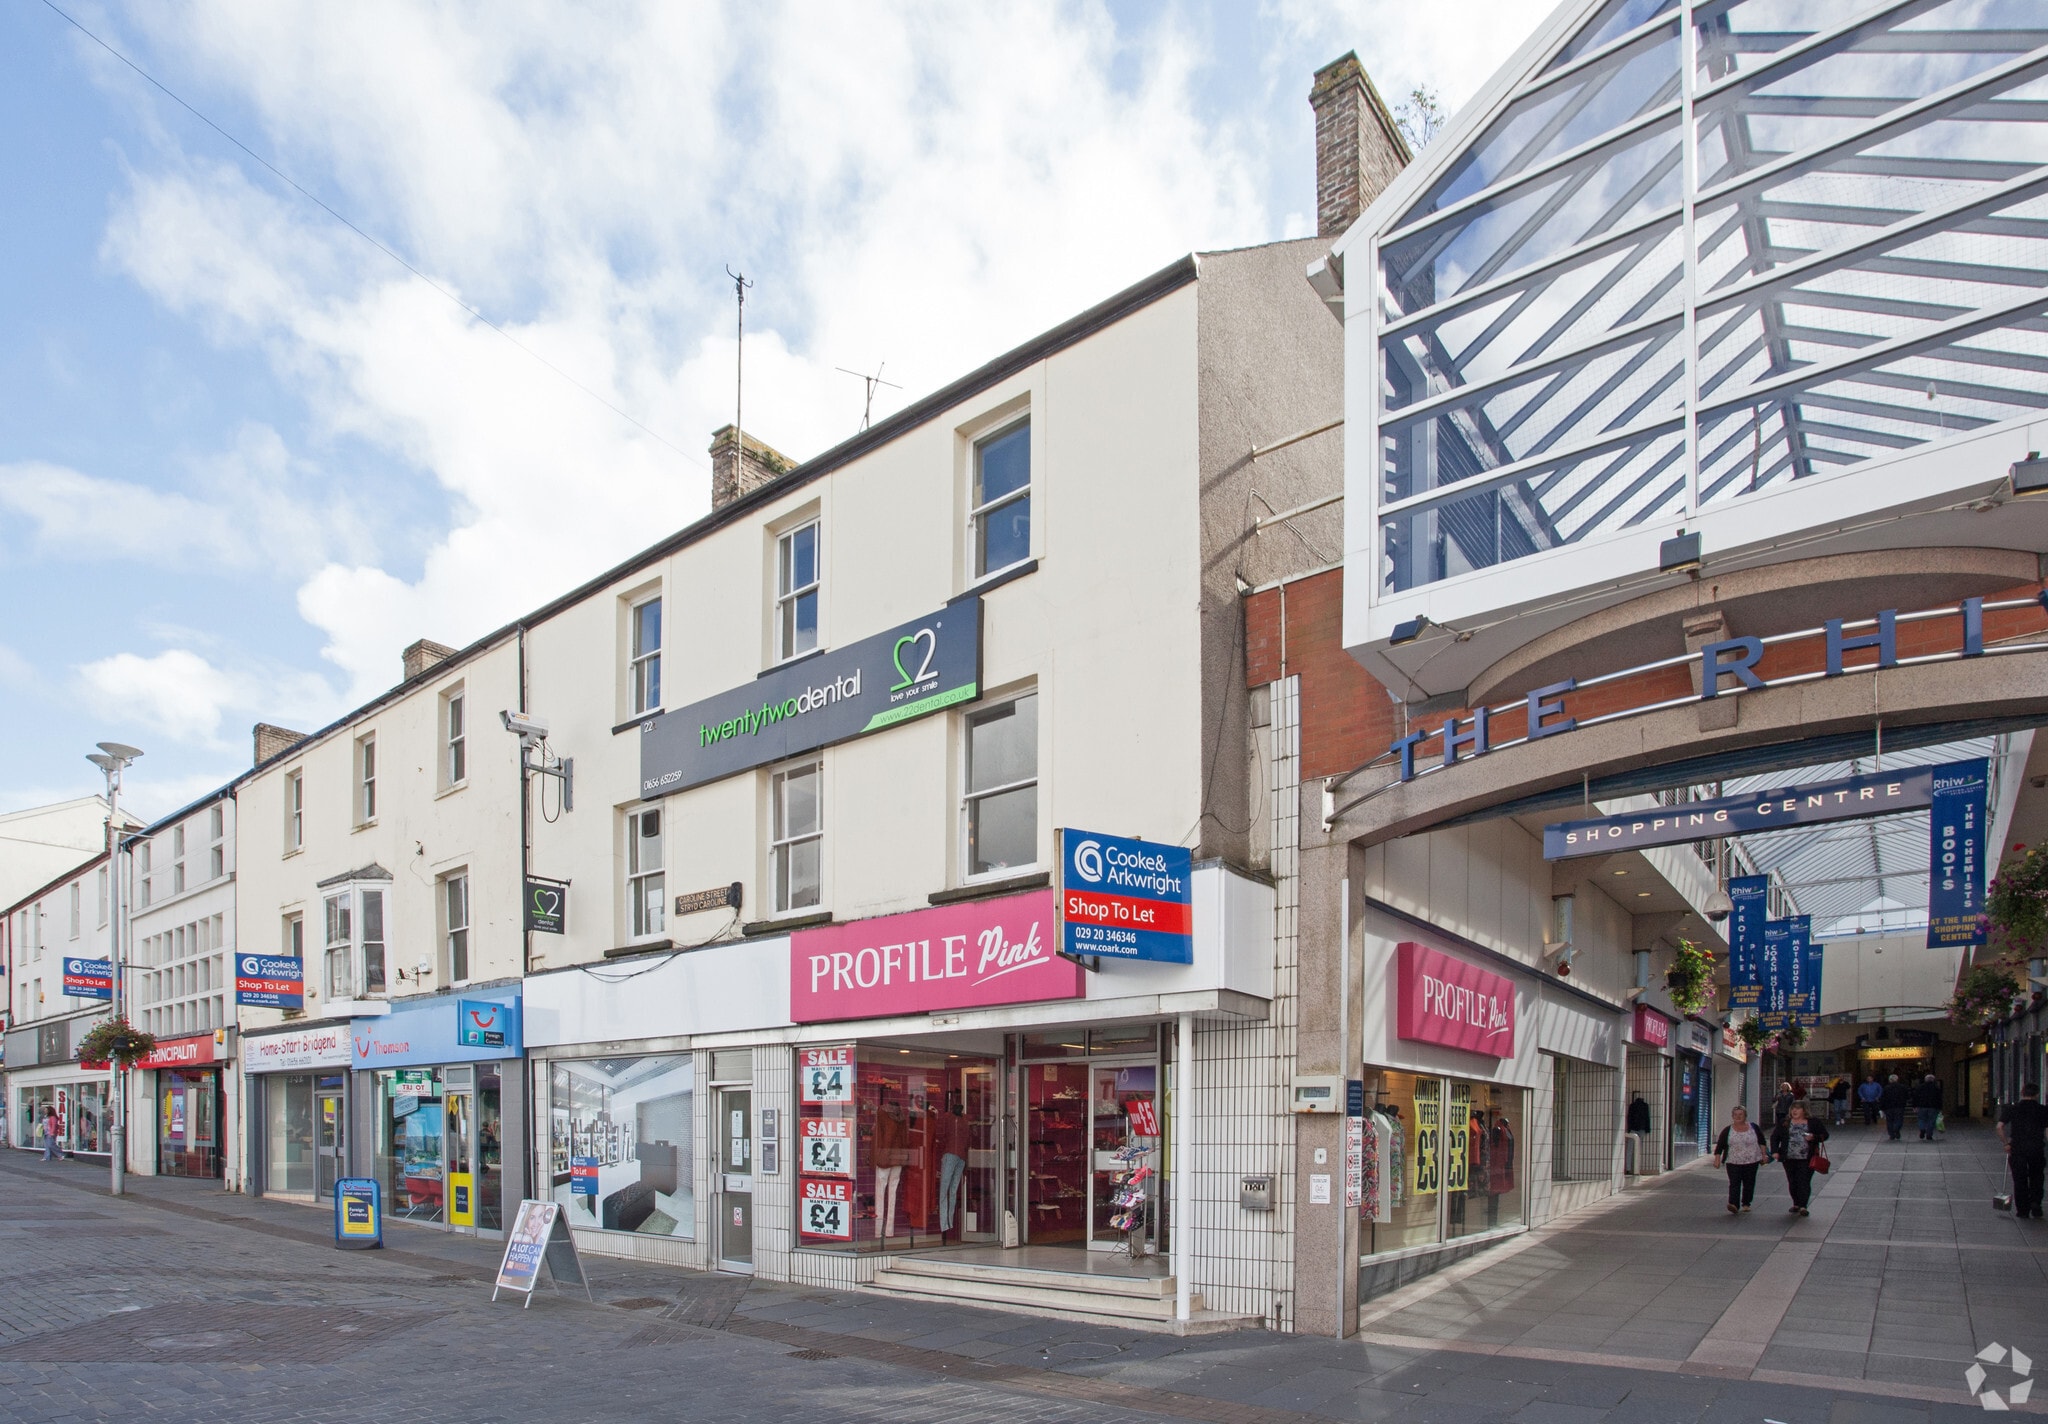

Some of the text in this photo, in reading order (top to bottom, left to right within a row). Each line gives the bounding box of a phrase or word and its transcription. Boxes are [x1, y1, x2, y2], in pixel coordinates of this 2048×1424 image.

[890, 680, 939, 703] love your smile
[1391, 588, 2048, 782] THE RHI
[880, 688, 970, 725] www.22dental.co.uk
[643, 770, 682, 791] 01656 652259
[1933, 776, 1964, 789] Rhiw
[1565, 782, 1902, 845] SHOPPING CENTRE
[1106, 846, 1167, 873] Cooke&
[1942, 825, 1956, 891] BOOTS
[1963, 803, 1974, 908] THE CHEMISTS
[1107, 866, 1182, 895] Arkwright
[679, 888, 728, 904] CAROLINE STREET
[680, 896, 727, 912] STRYD CAROLINE
[1069, 897, 1155, 923] Shop To Let
[1930, 918, 1940, 926] AT
[1943, 916, 1959, 924] THE
[1075, 926, 1137, 944] 029 20 346346
[1738, 905, 1746, 972] PROFILE
[1934, 924, 1976, 933] SHOPPING
[1940, 933, 1972, 942] CENTRE
[808, 920, 1043, 994] PROFILE Pink
[1075, 942, 1138, 955] www.coark.com
[260, 968, 303, 980] Arkwrigh
[1792, 939, 1800, 994] MOTAQUOTE
[66, 976, 85, 985] Shop
[238, 980, 290, 991] Shop To Let
[1422, 974, 1507, 1031] PROFILE Pink
[149, 1043, 198, 1064] PRINCIPALITY
[260, 1038, 301, 1056] Home-Start
[302, 1032, 336, 1056] Bridgend
[373, 1040, 410, 1056] Thomson
[807, 1050, 847, 1066] SALE
[812, 1071, 843, 1096] £4
[1415, 1078, 1441, 1101] LIMITE
[57, 1090, 67, 1138] SALE
[1138, 1102, 1158, 1134] £5
[1418, 1102, 1438, 1125] OFFER
[1450, 1105, 1467, 1126] FFER
[807, 1121, 847, 1137] SALE
[812, 1142, 842, 1168] £4
[1417, 1129, 1439, 1190] £3
[572, 1167, 588, 1176] To Let
[806, 1182, 846, 1200] SALE
[810, 1204, 840, 1230] £4
[508, 1252, 531, 1263] HAPPEN
[511, 1244, 516, 1252] A
[518, 1244, 528, 1253] LOT
